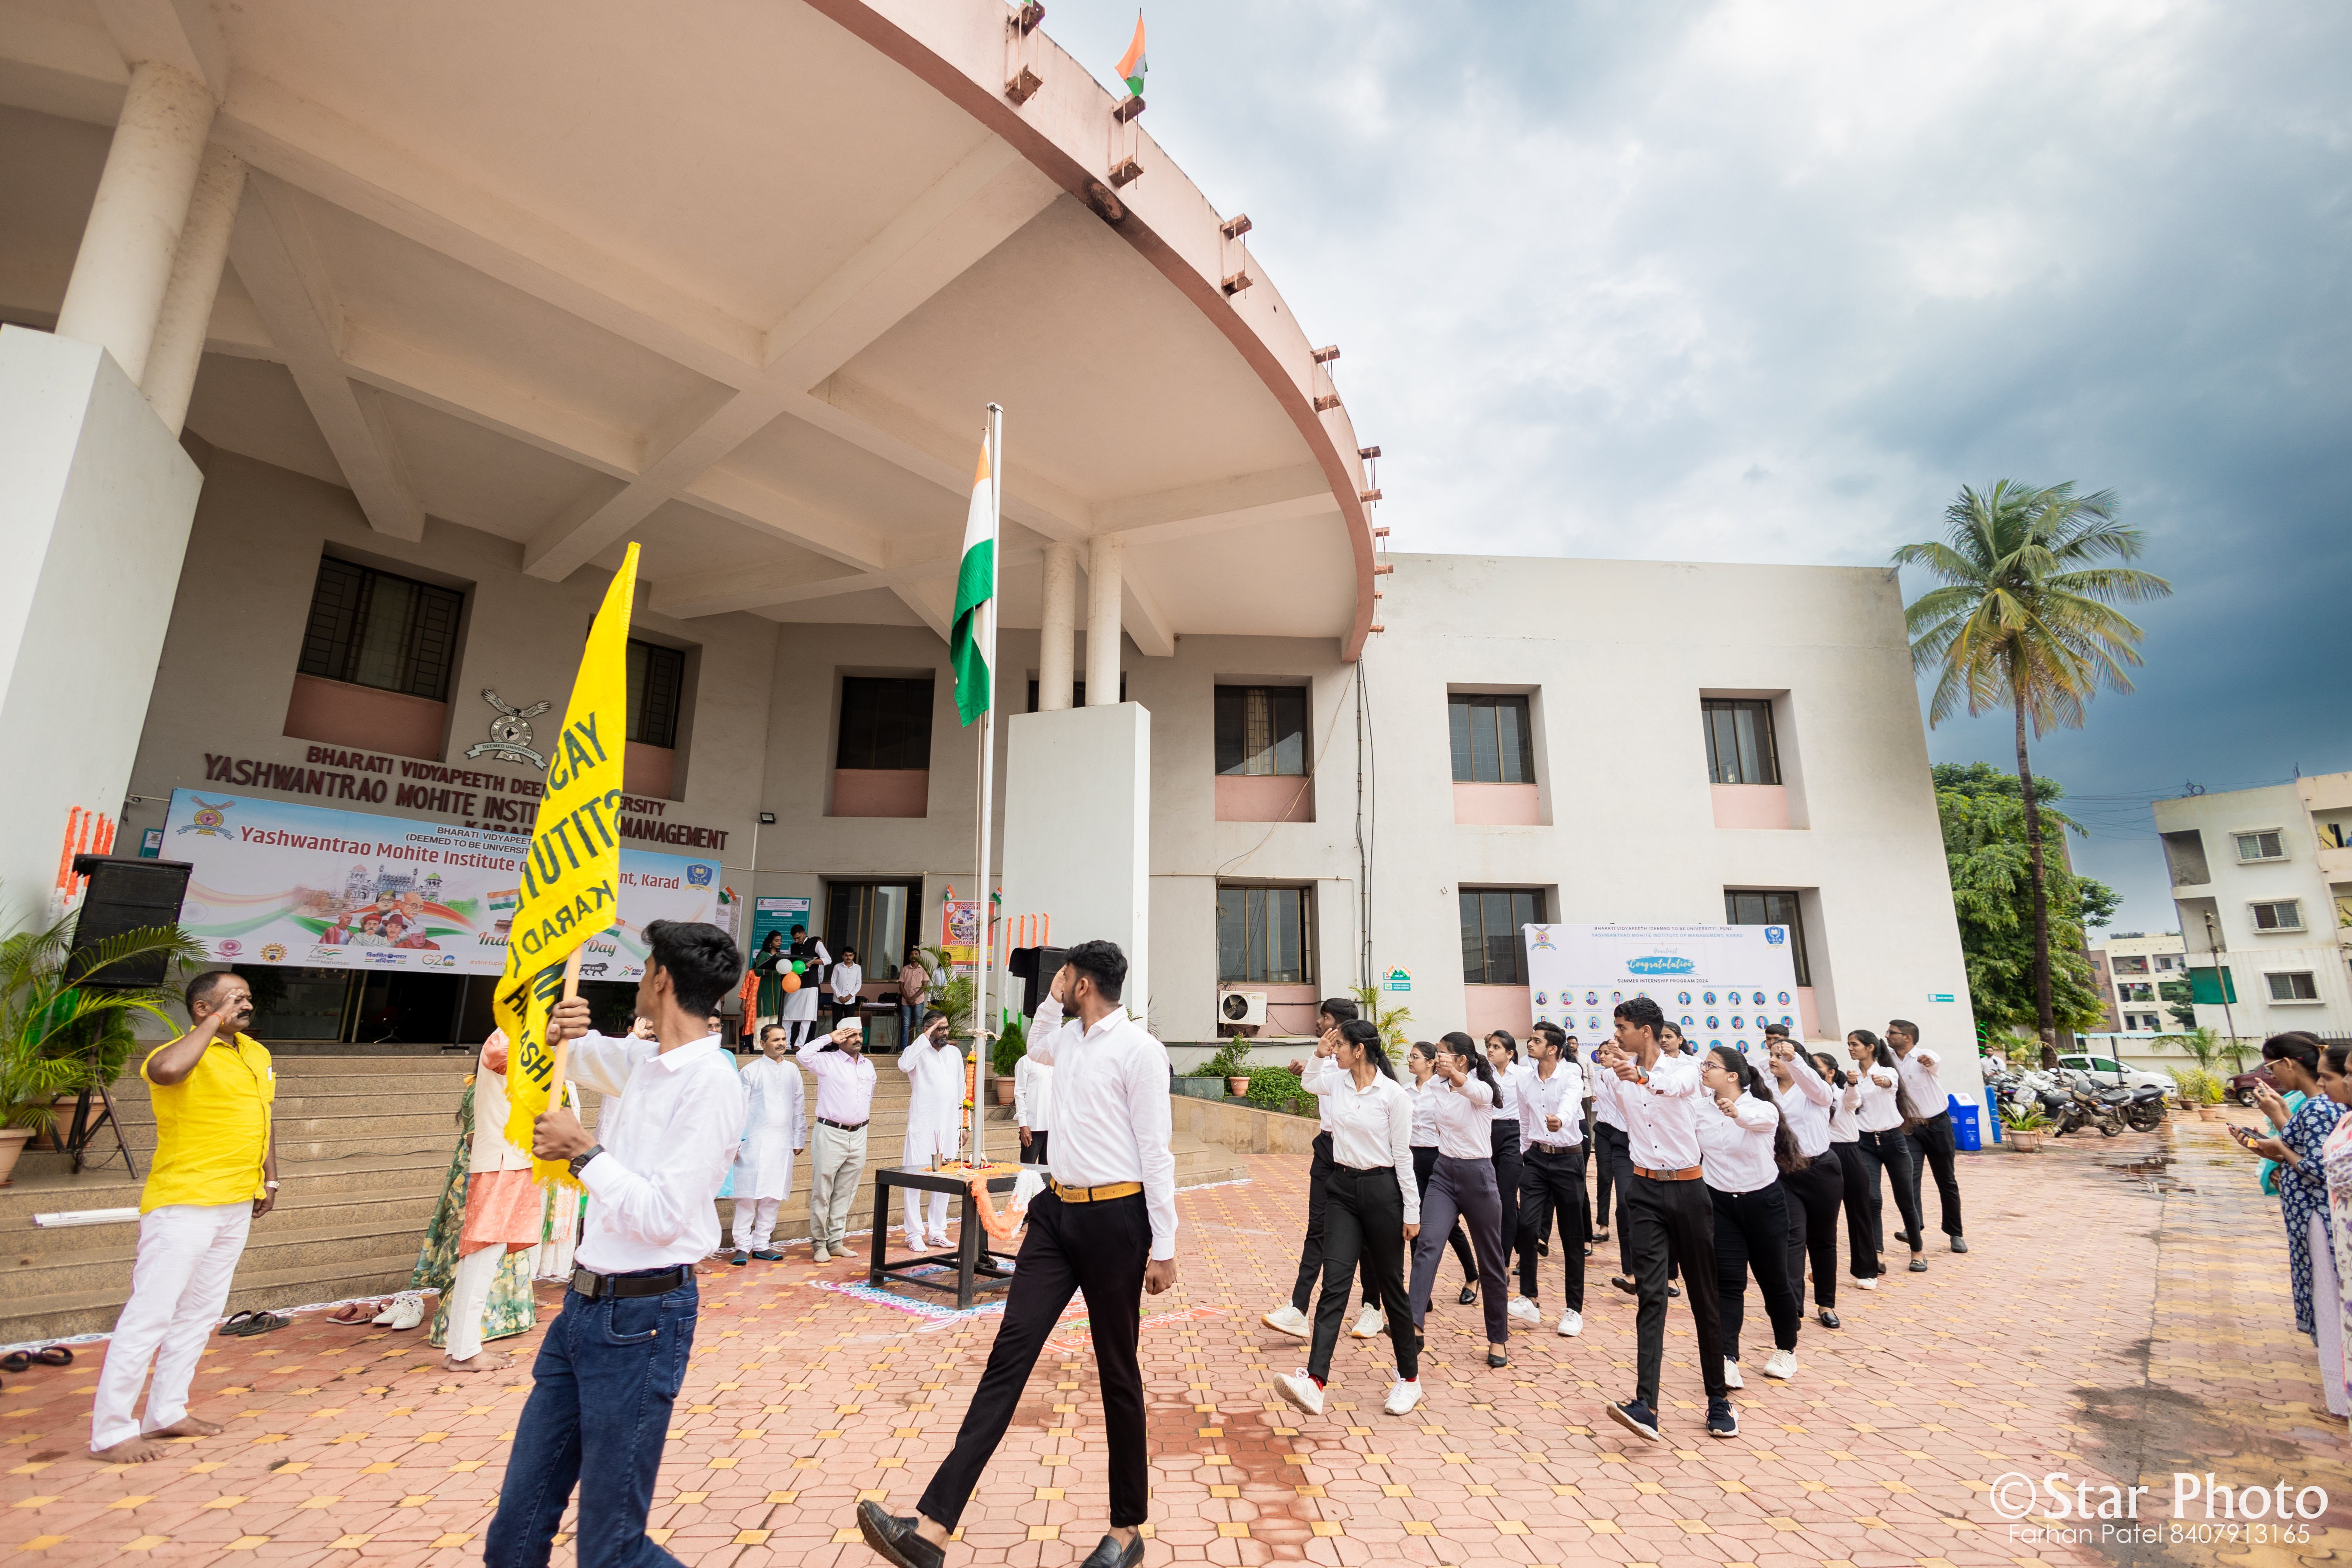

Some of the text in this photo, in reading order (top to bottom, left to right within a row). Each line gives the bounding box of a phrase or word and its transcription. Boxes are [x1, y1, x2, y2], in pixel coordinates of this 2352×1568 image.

[506, 744, 536, 757] UNIVERSITY
[306, 745, 394, 775] BHARATI
[401, 760, 505, 792] VIDYAPEETH
[205, 753, 729, 851] YASHWANTRAO MOHITE INSTI MANAGEMENT
[405, 833, 451, 845] (DEEMED
[453, 839, 467, 847] TO
[469, 841, 481, 849] BE
[436, 826, 479, 839] BHARATI
[241, 826, 371, 855] Yashwantrao
[376, 842, 439, 863] Mohite
[443, 850, 515, 872] Institute
[641, 873, 680, 890] Karad
[478, 931, 617, 957] Ind Day
